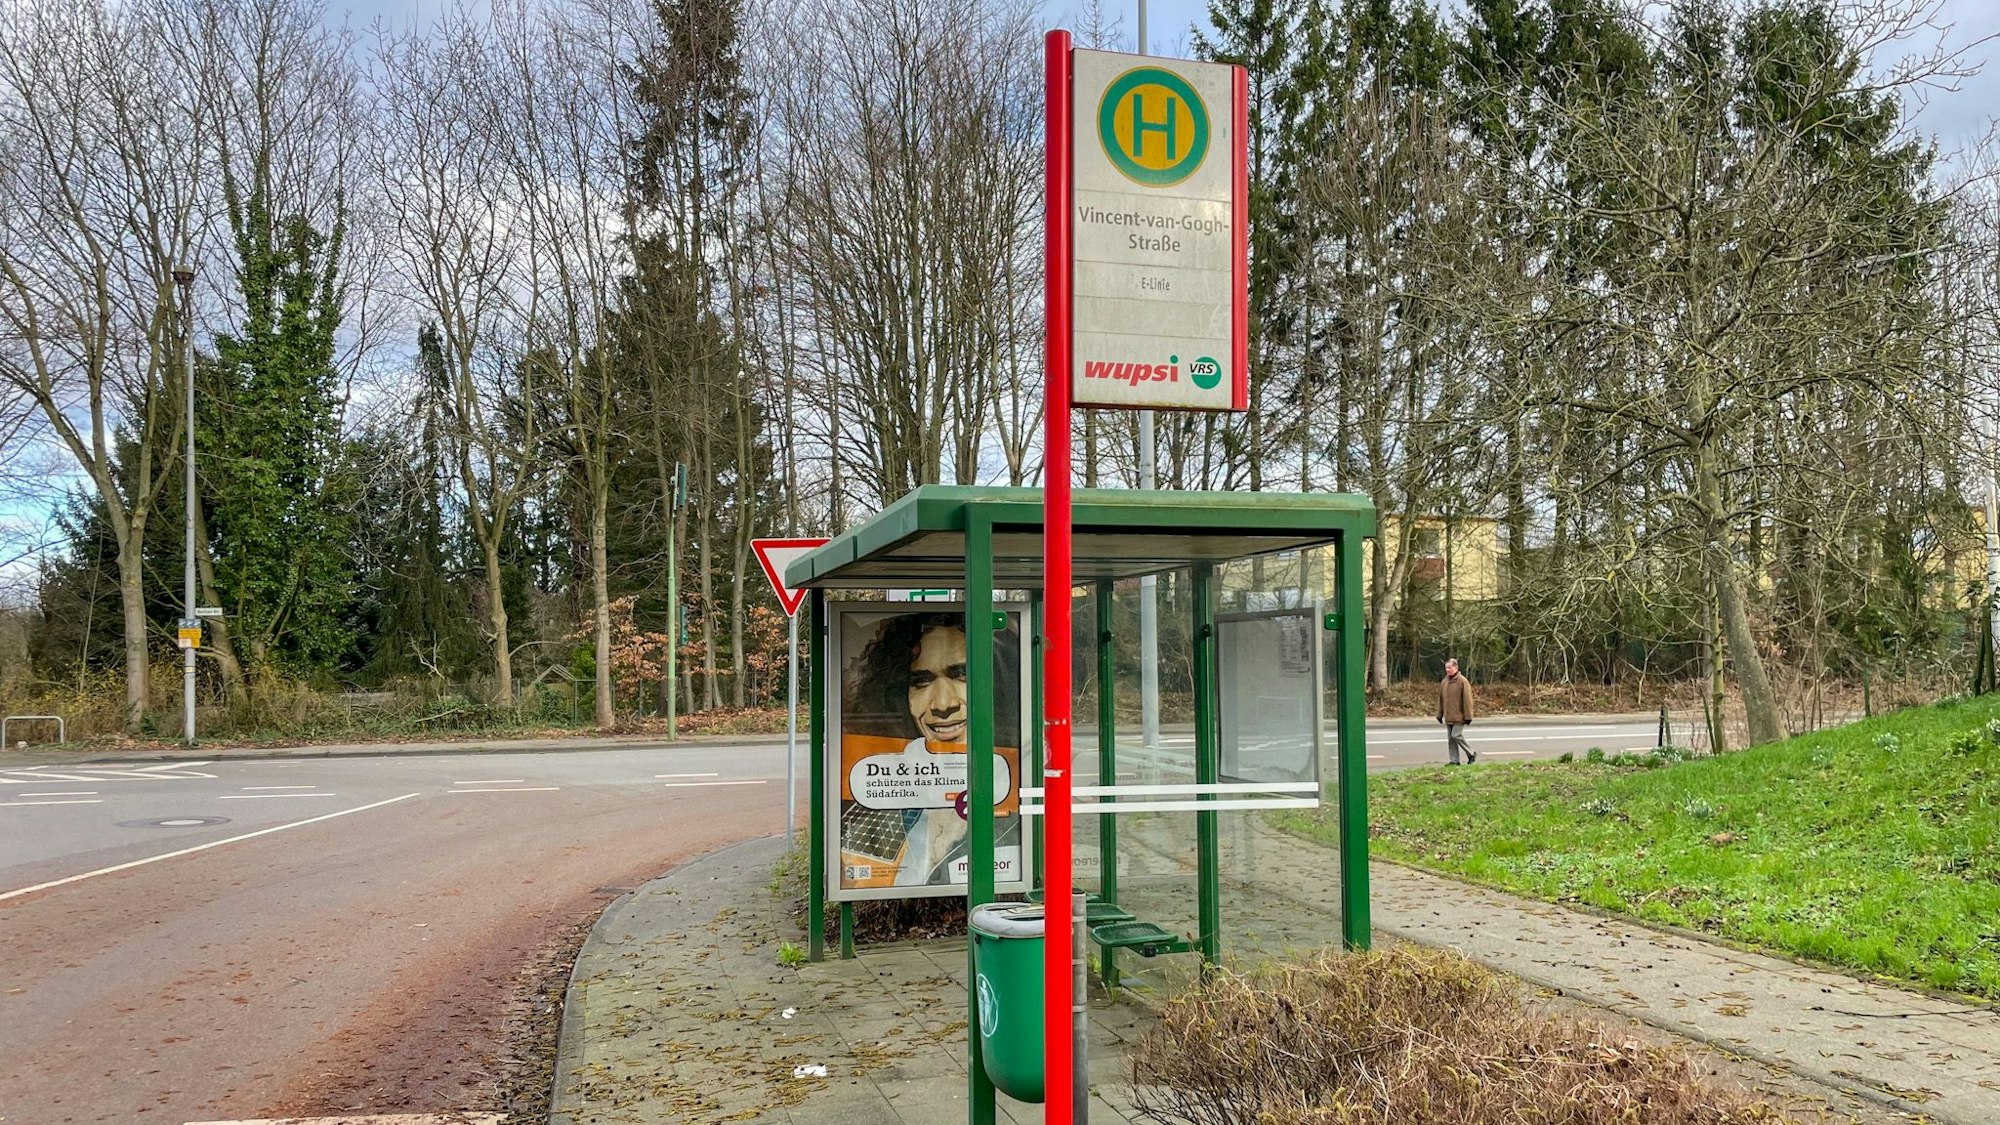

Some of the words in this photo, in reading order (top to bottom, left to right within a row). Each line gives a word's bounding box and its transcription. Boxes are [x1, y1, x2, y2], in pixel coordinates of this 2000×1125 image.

[1133, 93, 1176, 160] H
[1078, 205, 1230, 235] Vincent-van-Gogh-
[1129, 233, 1181, 252] Straße
[1141, 277, 1171, 291] E-Linie
[1085, 354, 1179, 386] wupsi
[1189, 362, 1214, 375] VRS
[866, 763, 891, 776] Du
[896, 763, 909, 776] &
[914, 762, 940, 775] ich
[866, 777, 912, 787] schützen
[914, 777, 932, 786] das
[934, 776, 965, 786] Klima
[866, 789, 919, 798] Südafrika.
